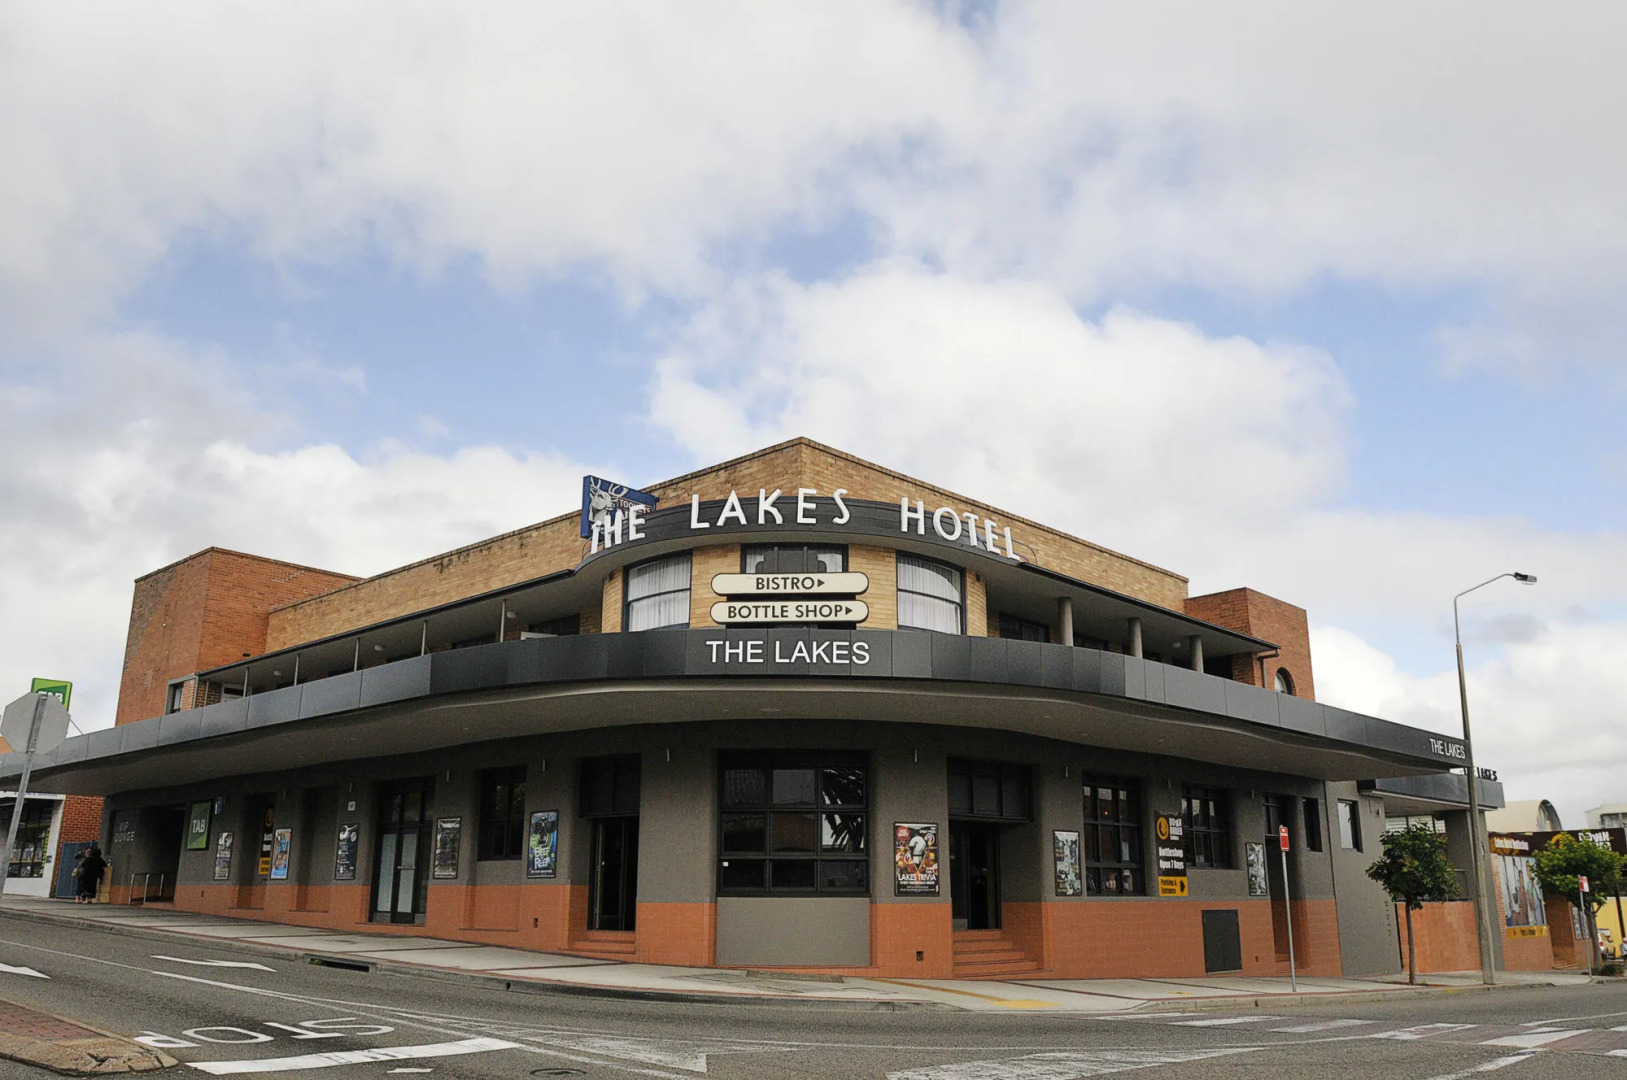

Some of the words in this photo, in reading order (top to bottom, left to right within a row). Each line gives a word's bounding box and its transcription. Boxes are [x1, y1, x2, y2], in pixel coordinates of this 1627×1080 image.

[590, 504, 646, 555] THE
[690, 487, 850, 529] LAKES
[900, 496, 1021, 562] HOTEL
[756, 576, 815, 590] BISTRO
[727, 605, 789, 619] BOTTLE
[795, 604, 843, 618] SHOP
[705, 640, 764, 663] THE
[775, 640, 870, 664] LAKES
[1430, 738, 1444, 754] THE
[1444, 742, 1466, 759] LAKES
[192, 819, 206, 833] TAB
[134, 1017, 395, 1048] STOP
